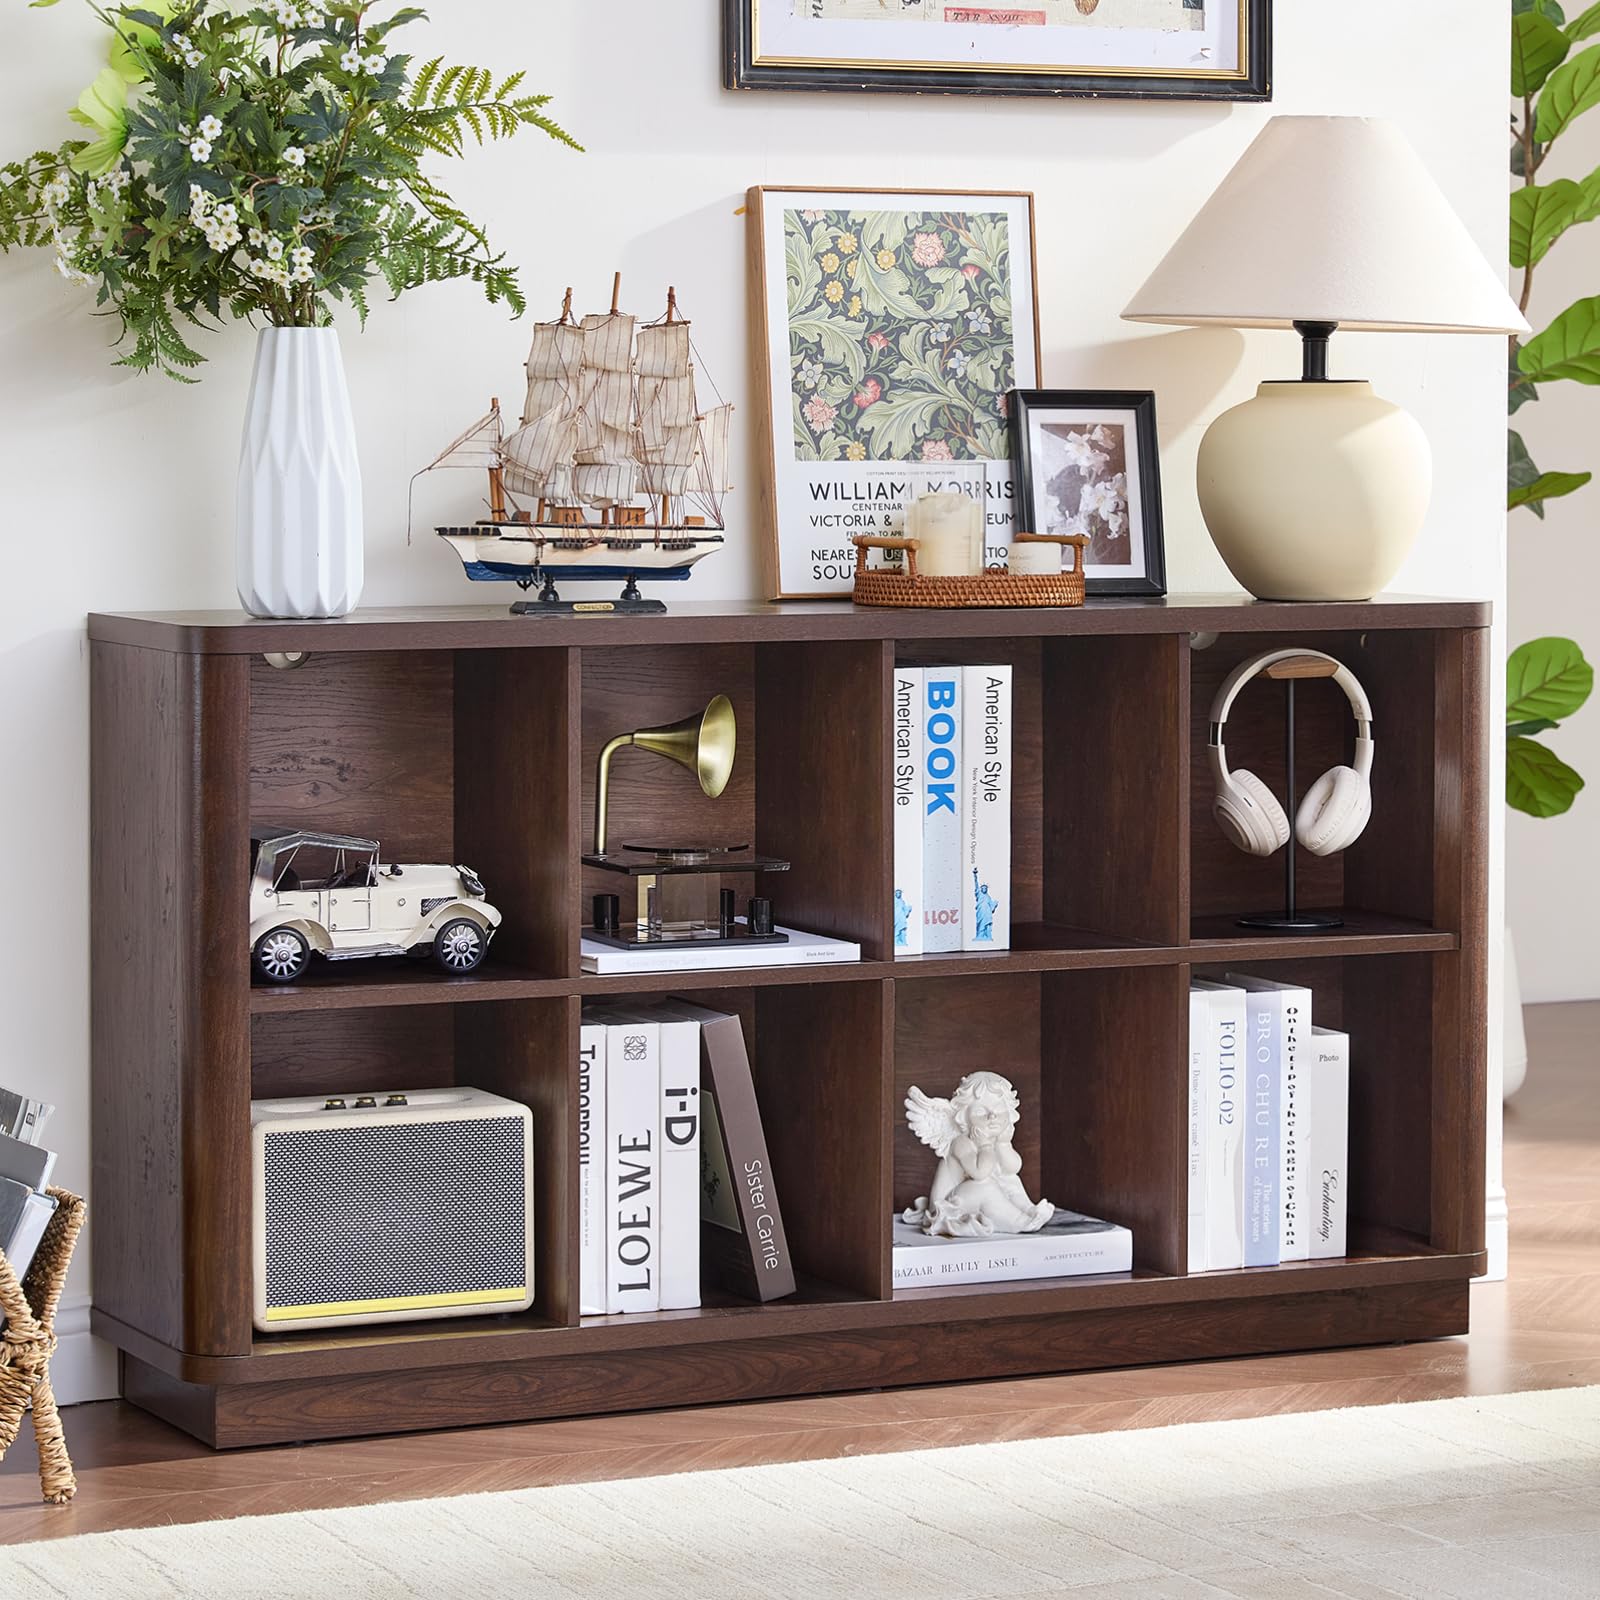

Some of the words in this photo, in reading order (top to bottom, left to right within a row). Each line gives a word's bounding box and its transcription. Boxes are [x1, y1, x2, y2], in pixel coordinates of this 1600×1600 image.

[809, 481, 906, 500] WILLIAM
[852, 502, 903, 511] CENTENAR
[809, 514, 876, 527] VICTORIA
[883, 514, 893, 527] &
[811, 548, 871, 561] NEARET
[896, 679, 915, 759] American
[984, 676, 1003, 755] American
[926, 681, 956, 816] BOOK
[893, 764, 914, 806] Style
[979, 760, 1002, 802] Style
[924, 909, 960, 925] 2011
[1256, 1011, 1272, 1063] BRO
[1318, 1053, 1340, 1063] Photo
[1218, 1020, 1236, 1125] FOLIO-02
[665, 1086, 698, 1146] i-D
[1255, 1073, 1270, 1126] CHU
[1254, 1135, 1269, 1169] RE
[744, 1159, 767, 1210] Sister
[618, 1129, 651, 1293] LOEWE
[755, 1214, 779, 1270] Carrie
[895, 1265, 934, 1279] BAZAAR
